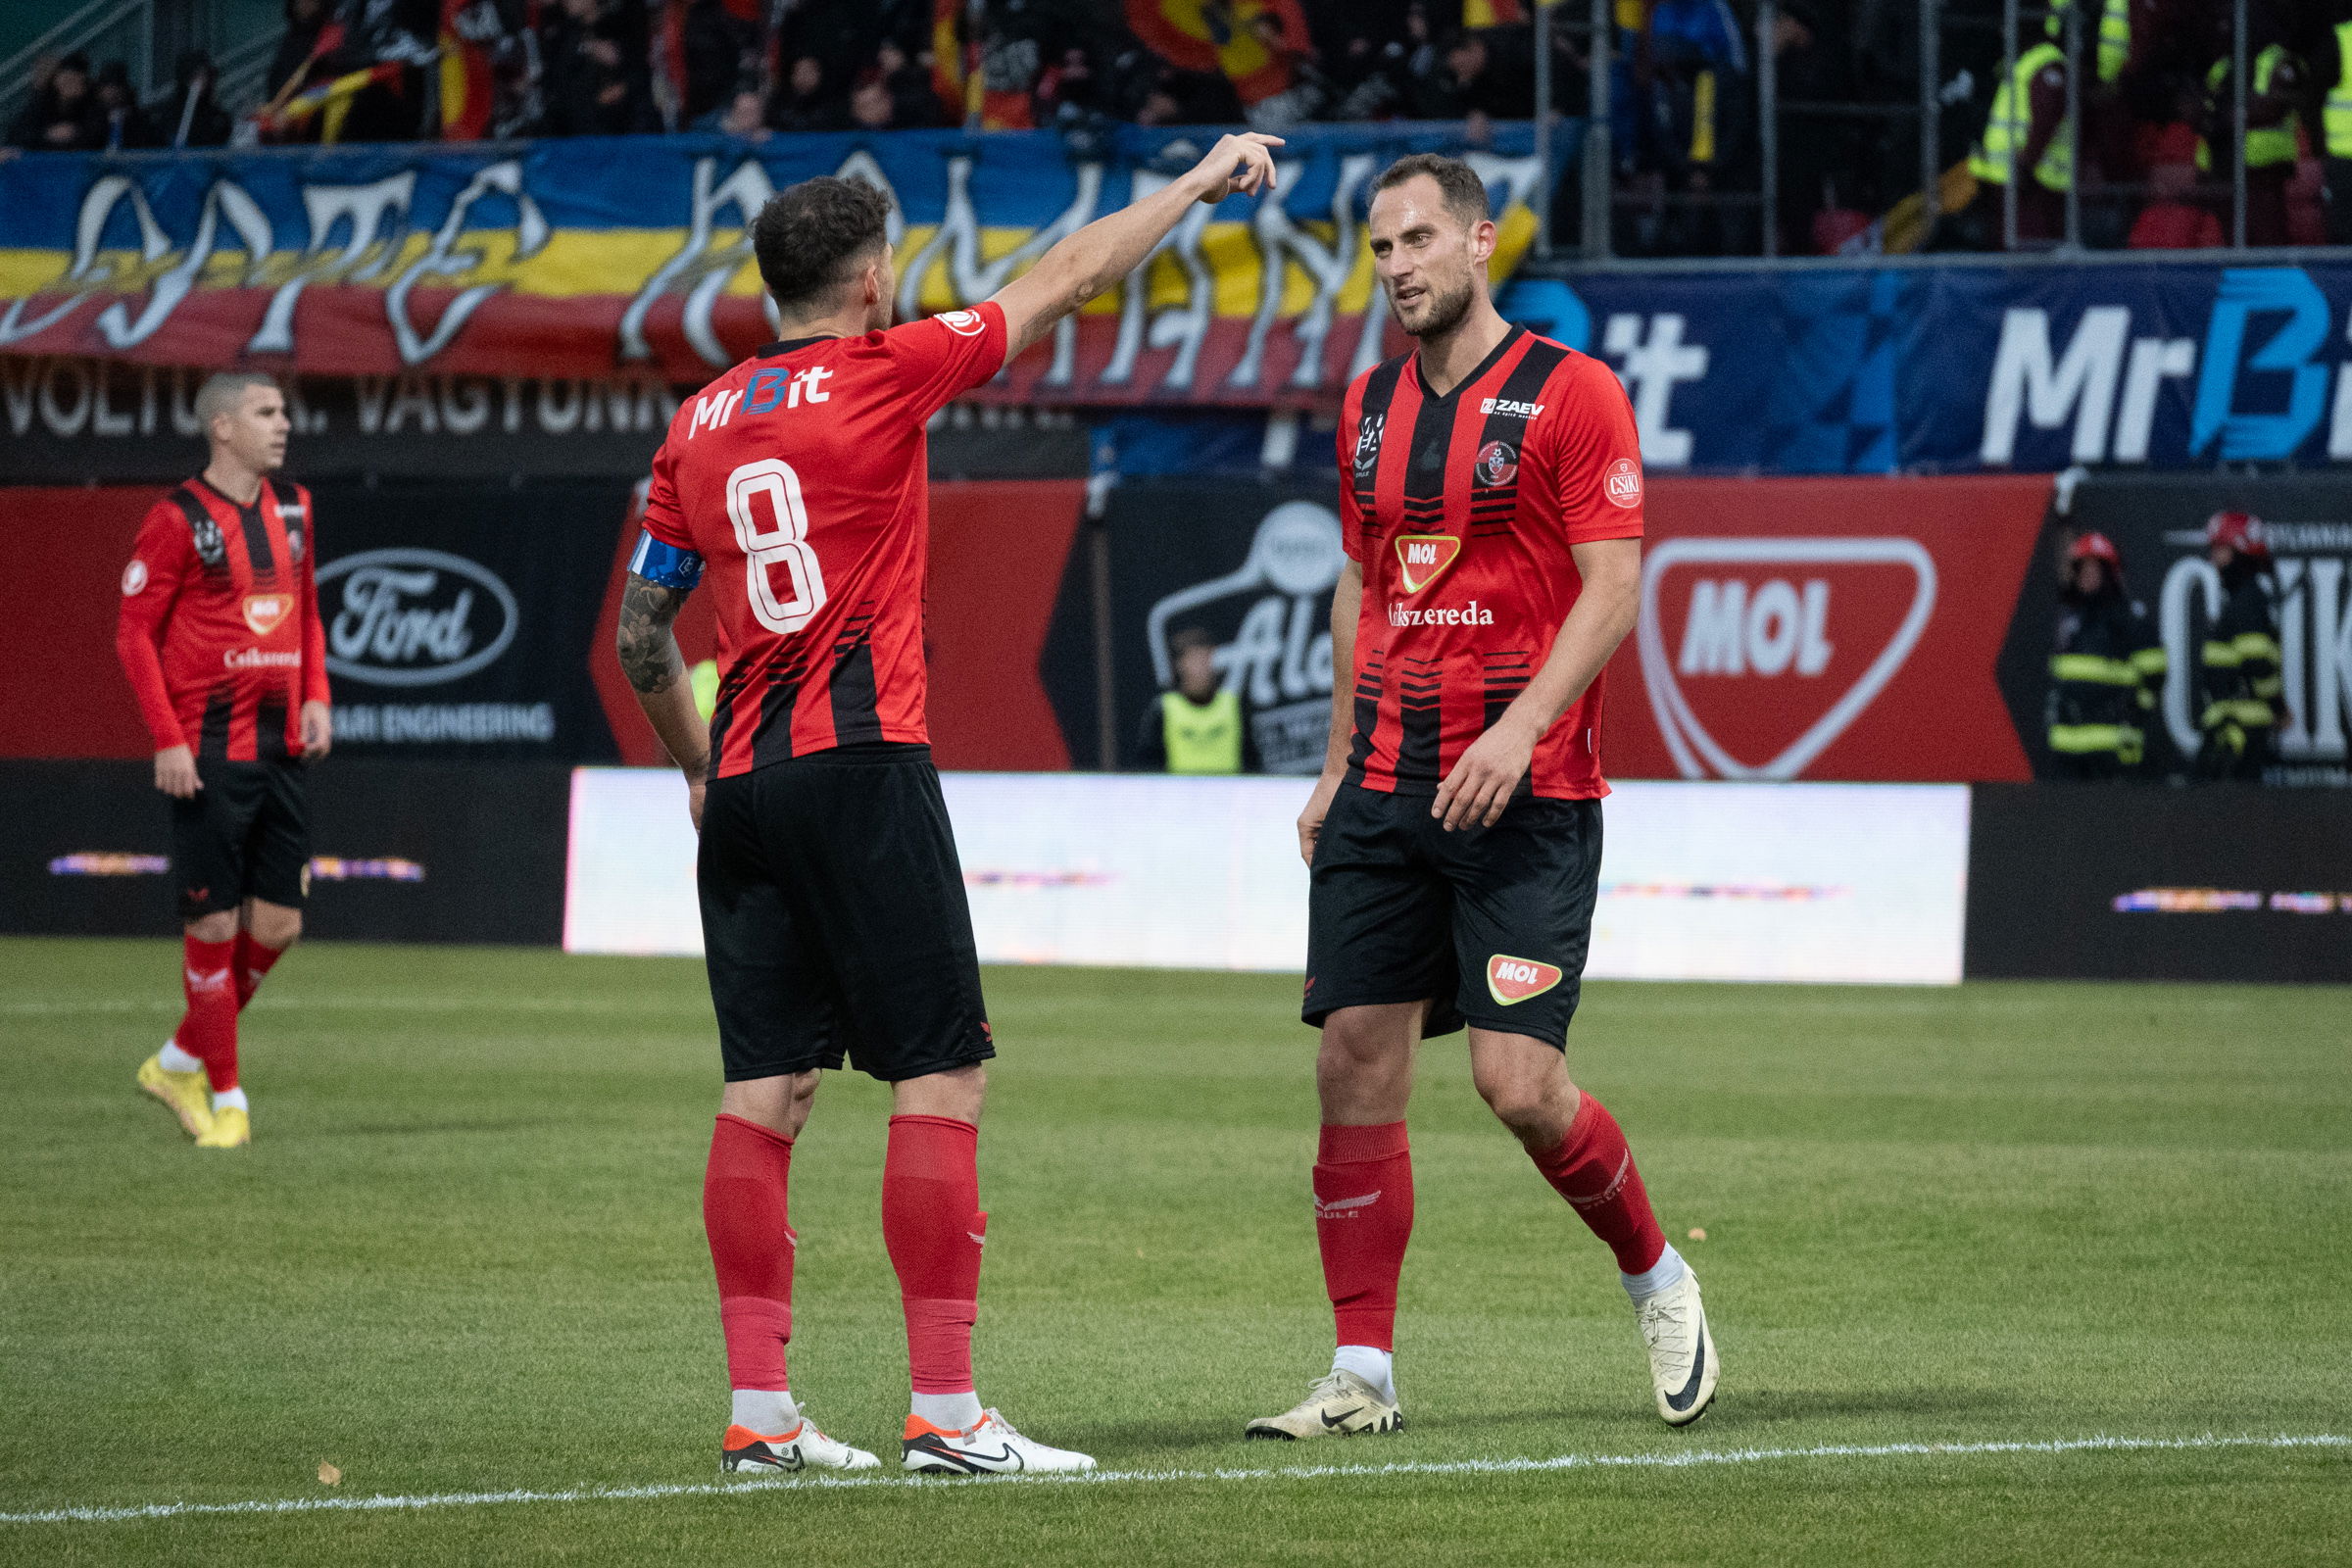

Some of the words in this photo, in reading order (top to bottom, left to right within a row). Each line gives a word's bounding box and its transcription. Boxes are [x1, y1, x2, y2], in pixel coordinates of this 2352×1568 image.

[688, 366, 833, 440] MrBit
[1495, 399, 1545, 416] ZAEV
[726, 458, 827, 635] 8
[1407, 543, 1437, 564] MOL
[331, 566, 473, 661] Ford
[1680, 580, 1832, 676] MOL
[1495, 961, 1539, 985] MOL
